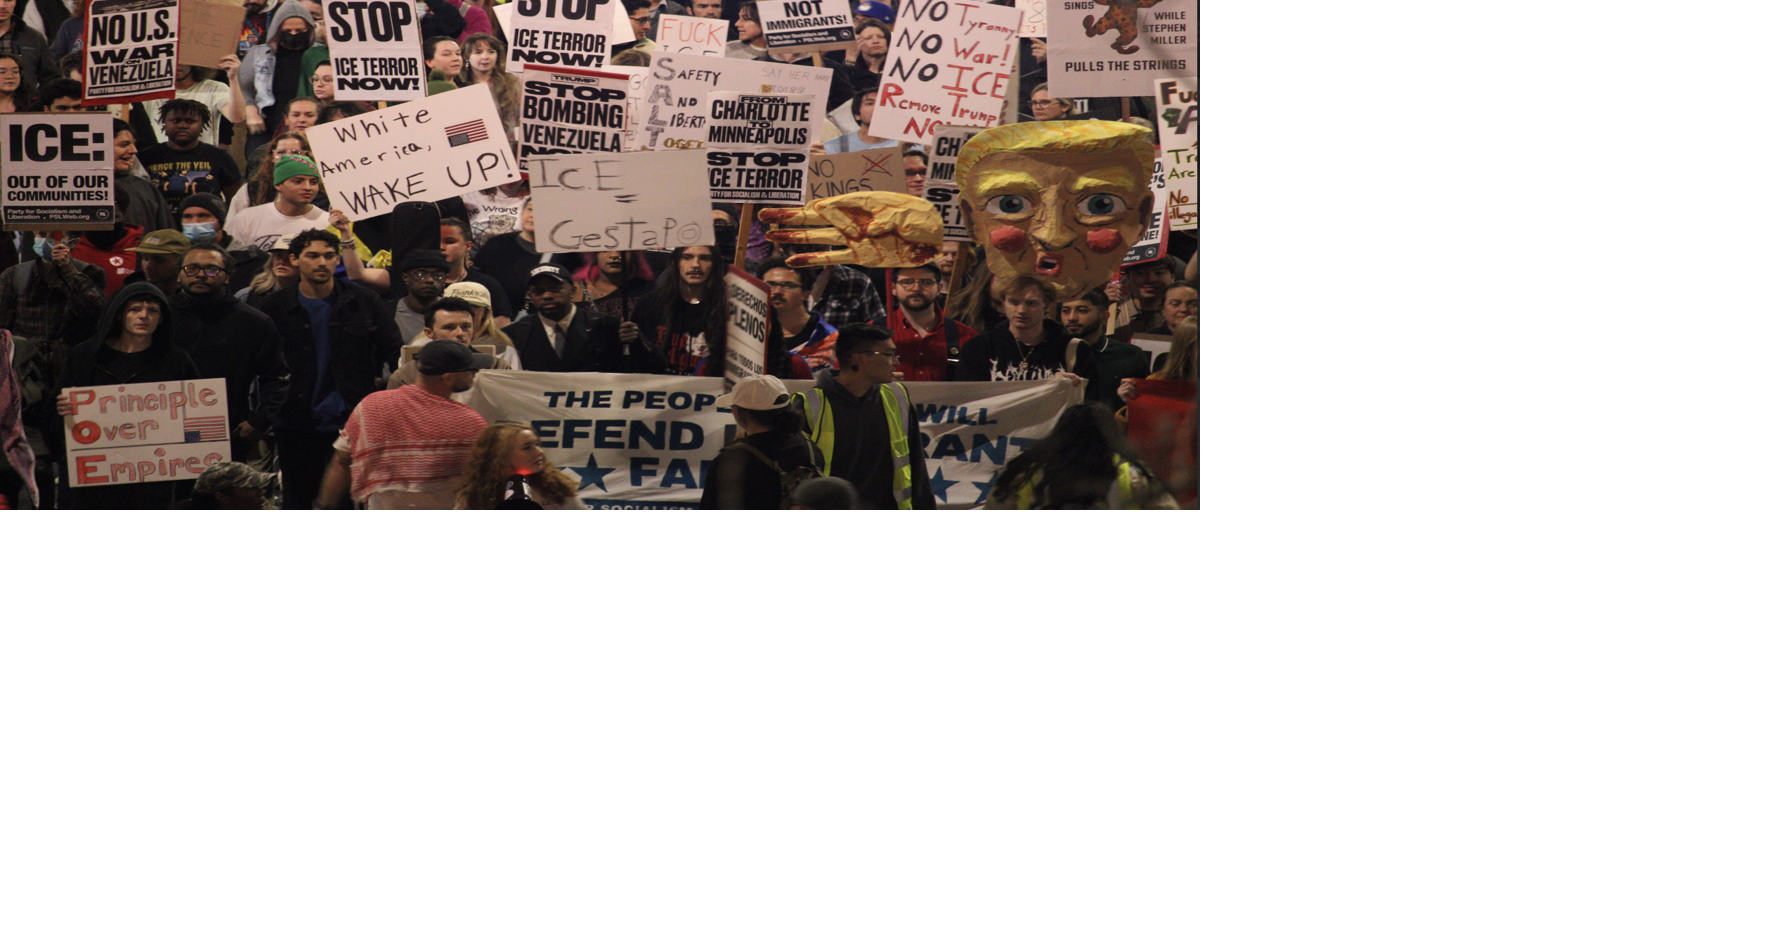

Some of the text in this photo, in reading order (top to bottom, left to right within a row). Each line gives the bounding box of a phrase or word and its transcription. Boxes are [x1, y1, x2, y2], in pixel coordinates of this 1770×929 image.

[783, 0, 823, 18] NOT
[1064, 2, 1094, 10] SINGS
[1154, 11, 1186, 20] WHILE
[91, 15, 126, 47] NO
[131, 9, 175, 43] U.S.
[328, 1, 412, 42] STOP
[766, 14, 848, 31] IMMIGRANTS!
[1142, 24, 1186, 33] STEPHEN
[513, 28, 606, 54] ICE TERROR
[661, 18, 725, 47] FUCK
[1150, 35, 1187, 45] MILLER
[90, 43, 174, 65] WAR
[511, 49, 605, 68] NOW!
[953, 37, 1011, 67] War!
[90, 59, 173, 85] VENEZUELA
[335, 57, 419, 76] ICE TERROR
[762, 66, 783, 79] SAY
[789, 69, 810, 80] HER
[1065, 59, 1186, 72] PULLS THE STRINGS
[337, 77, 420, 91] NOW!
[553, 75, 596, 84] TRUMP
[941, 64, 1010, 99] ICE
[524, 81, 626, 102] STOP
[741, 96, 786, 104] FROM
[523, 95, 624, 129] BOMBING
[711, 99, 810, 122] CHARLOTTE
[333, 109, 432, 143] White
[708, 125, 807, 145] MINNEAPOLIS
[9, 123, 105, 162] ICE:
[523, 123, 621, 152] VENEZUELA
[175, 162, 192, 171] THE
[320, 142, 432, 178] America,
[707, 152, 806, 167] STOP
[807, 159, 834, 179] NO
[7, 175, 108, 188] OUT OF OUR
[339, 148, 514, 215] WAKE UP!
[735, 168, 803, 189] TERROR
[7, 190, 108, 201] COMMUNITIES!
[721, 190, 731, 198] FOR
[732, 191, 760, 199] SOCIALISM
[768, 191, 800, 200] LIBERATION
[811, 178, 873, 200] KINGS
[1169, 189, 1189, 206] No
[482, 205, 518, 215] Wrong
[69, 382, 218, 420] Principle
[544, 390, 613, 408] THE
[916, 403, 998, 426] WILL
[72, 420, 159, 444] Over
